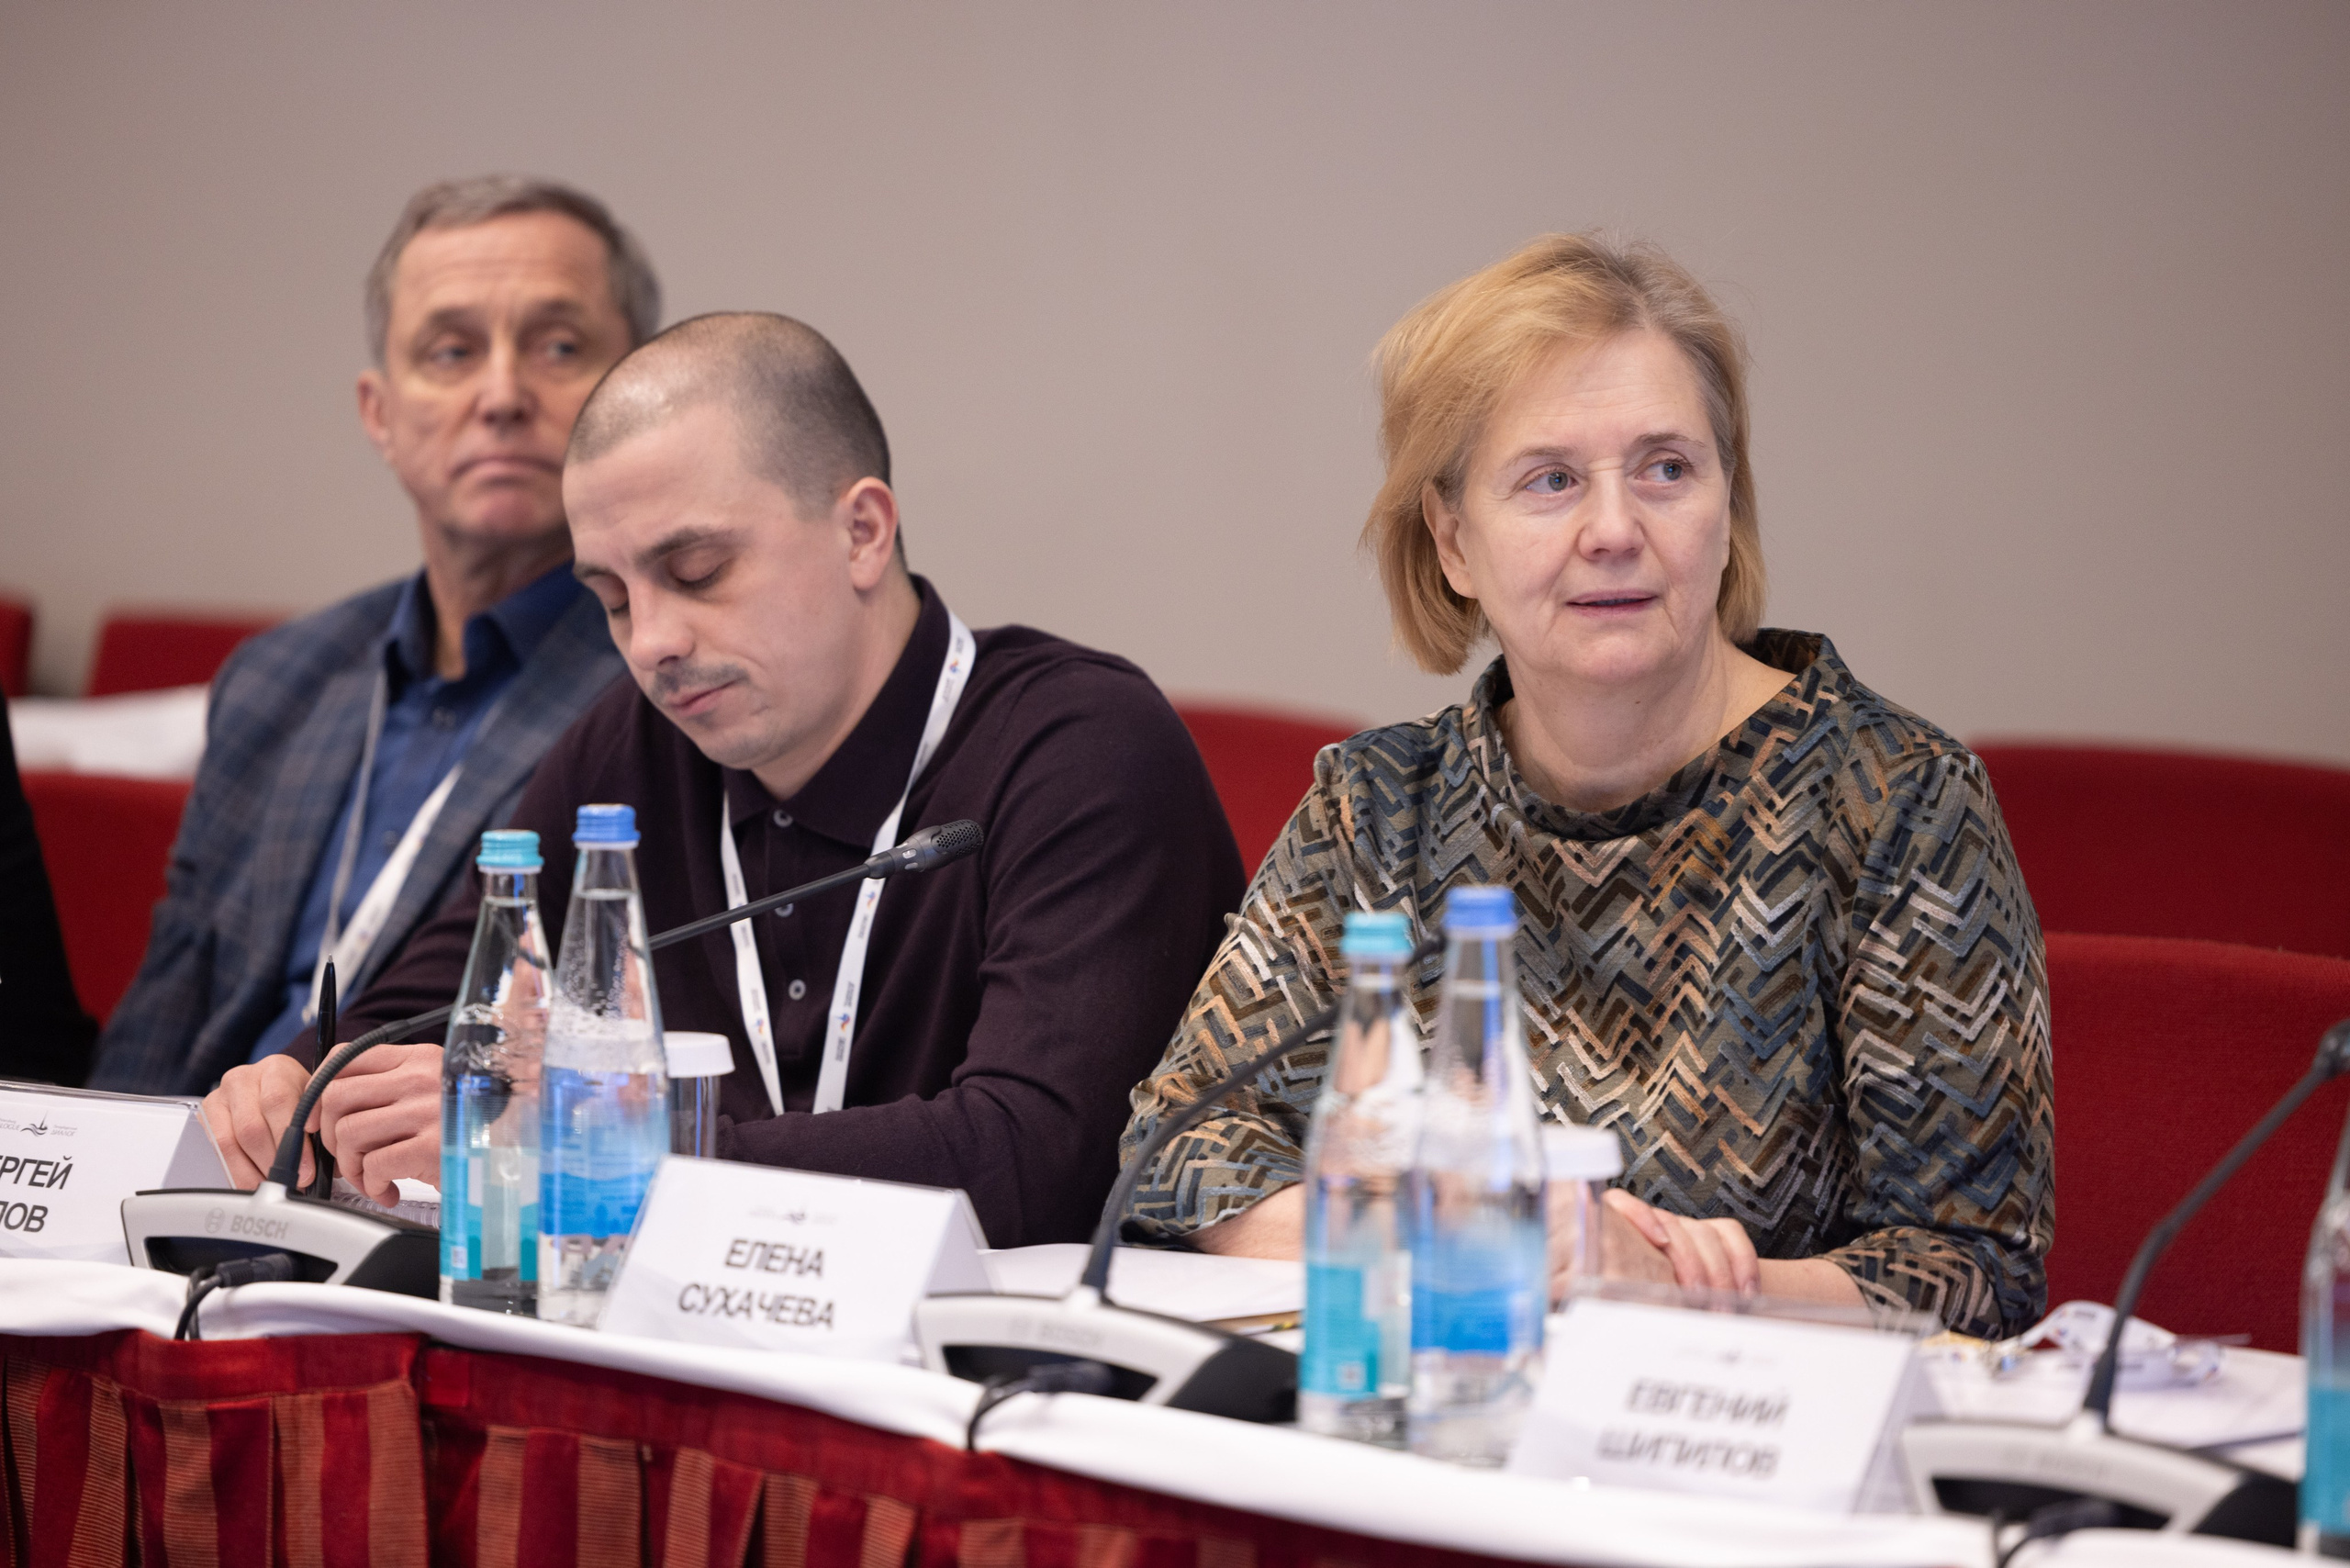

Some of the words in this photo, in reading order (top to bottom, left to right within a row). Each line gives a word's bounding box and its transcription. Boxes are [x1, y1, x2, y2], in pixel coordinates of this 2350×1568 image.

[0, 1155, 73, 1190] РГЕЙ
[229, 1215, 289, 1239] BOSCH
[723, 1238, 824, 1278] ЕЛЕНА
[677, 1282, 835, 1329] СУХАЧЕВА
[1625, 1377, 1790, 1428] ЕВГЕНИЙ
